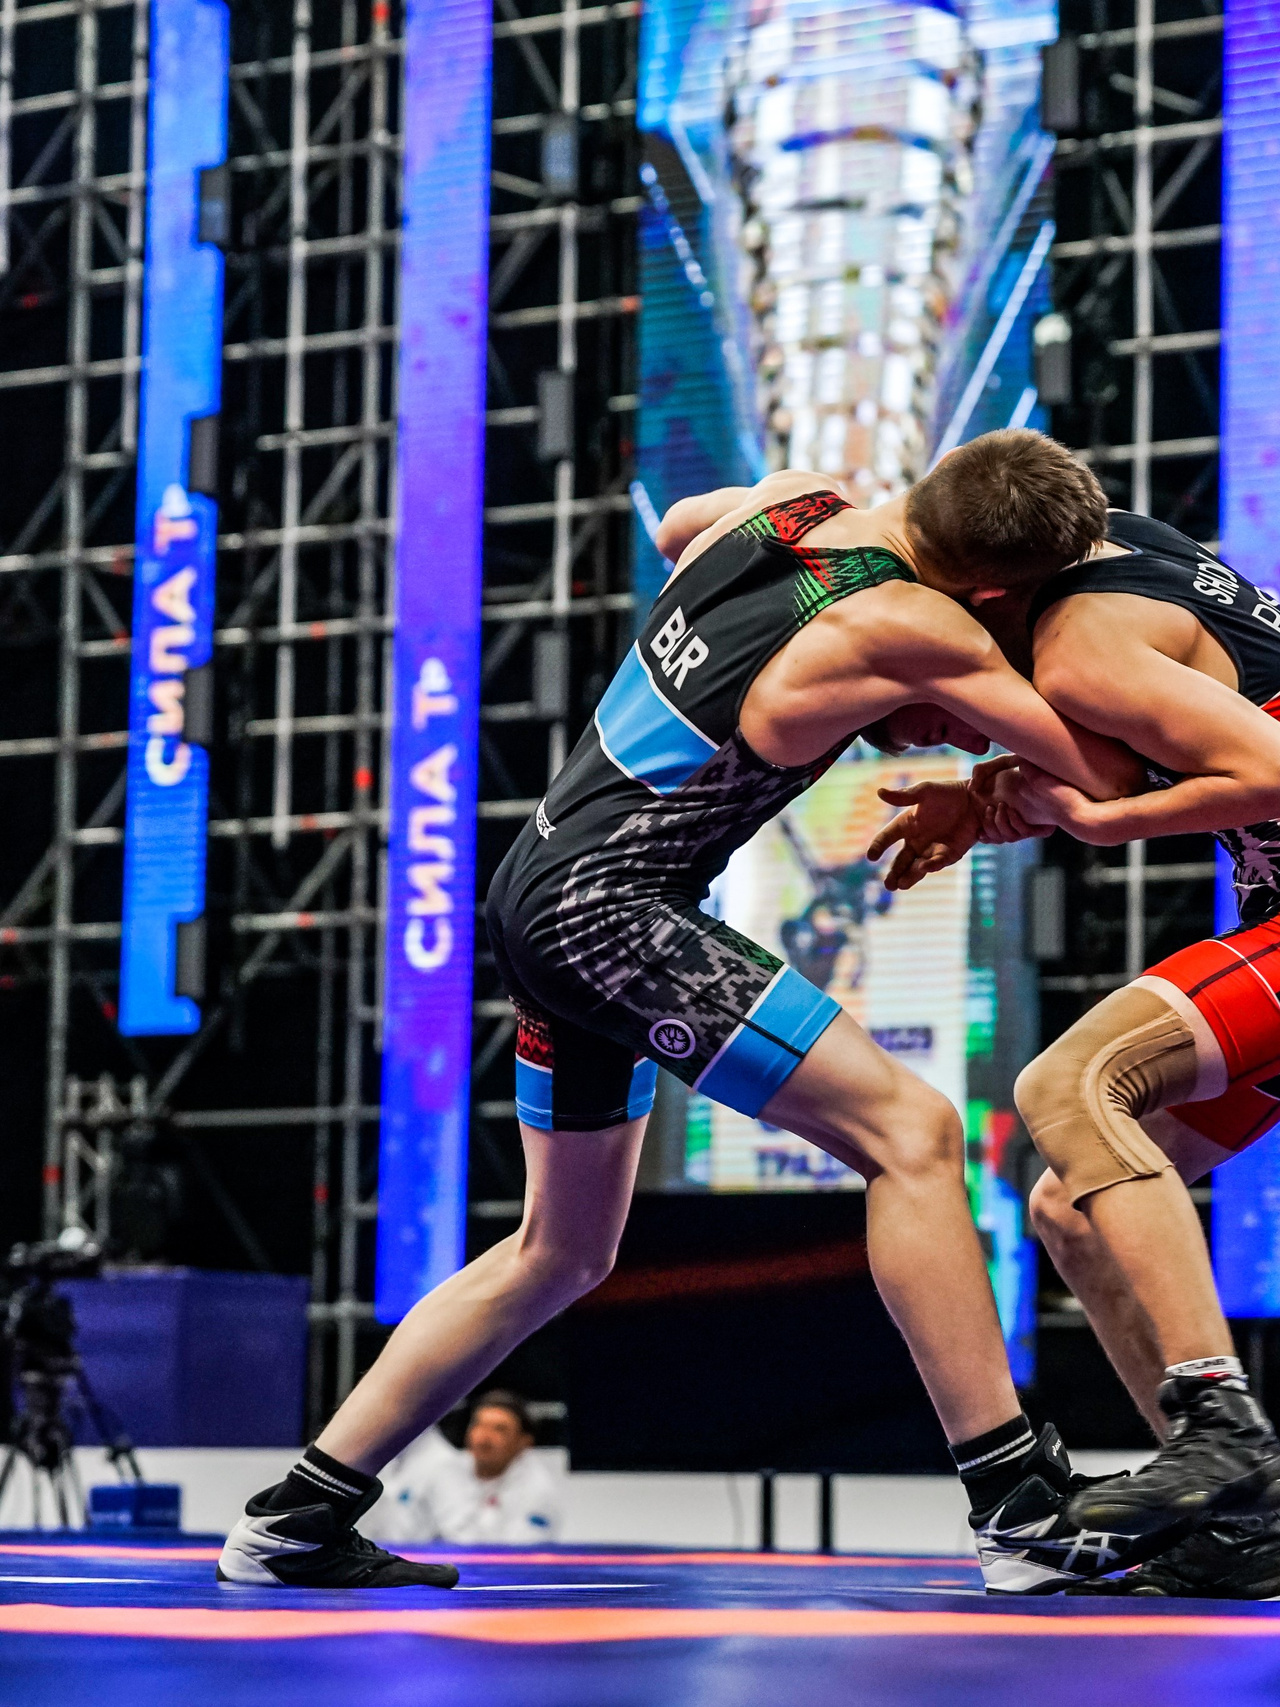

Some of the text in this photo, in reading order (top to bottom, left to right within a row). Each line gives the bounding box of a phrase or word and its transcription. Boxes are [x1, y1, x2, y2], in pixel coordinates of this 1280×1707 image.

[146, 567, 196, 786] СИЛА
[650, 606, 709, 691] BLR
[404, 743, 458, 971] СИЛА
